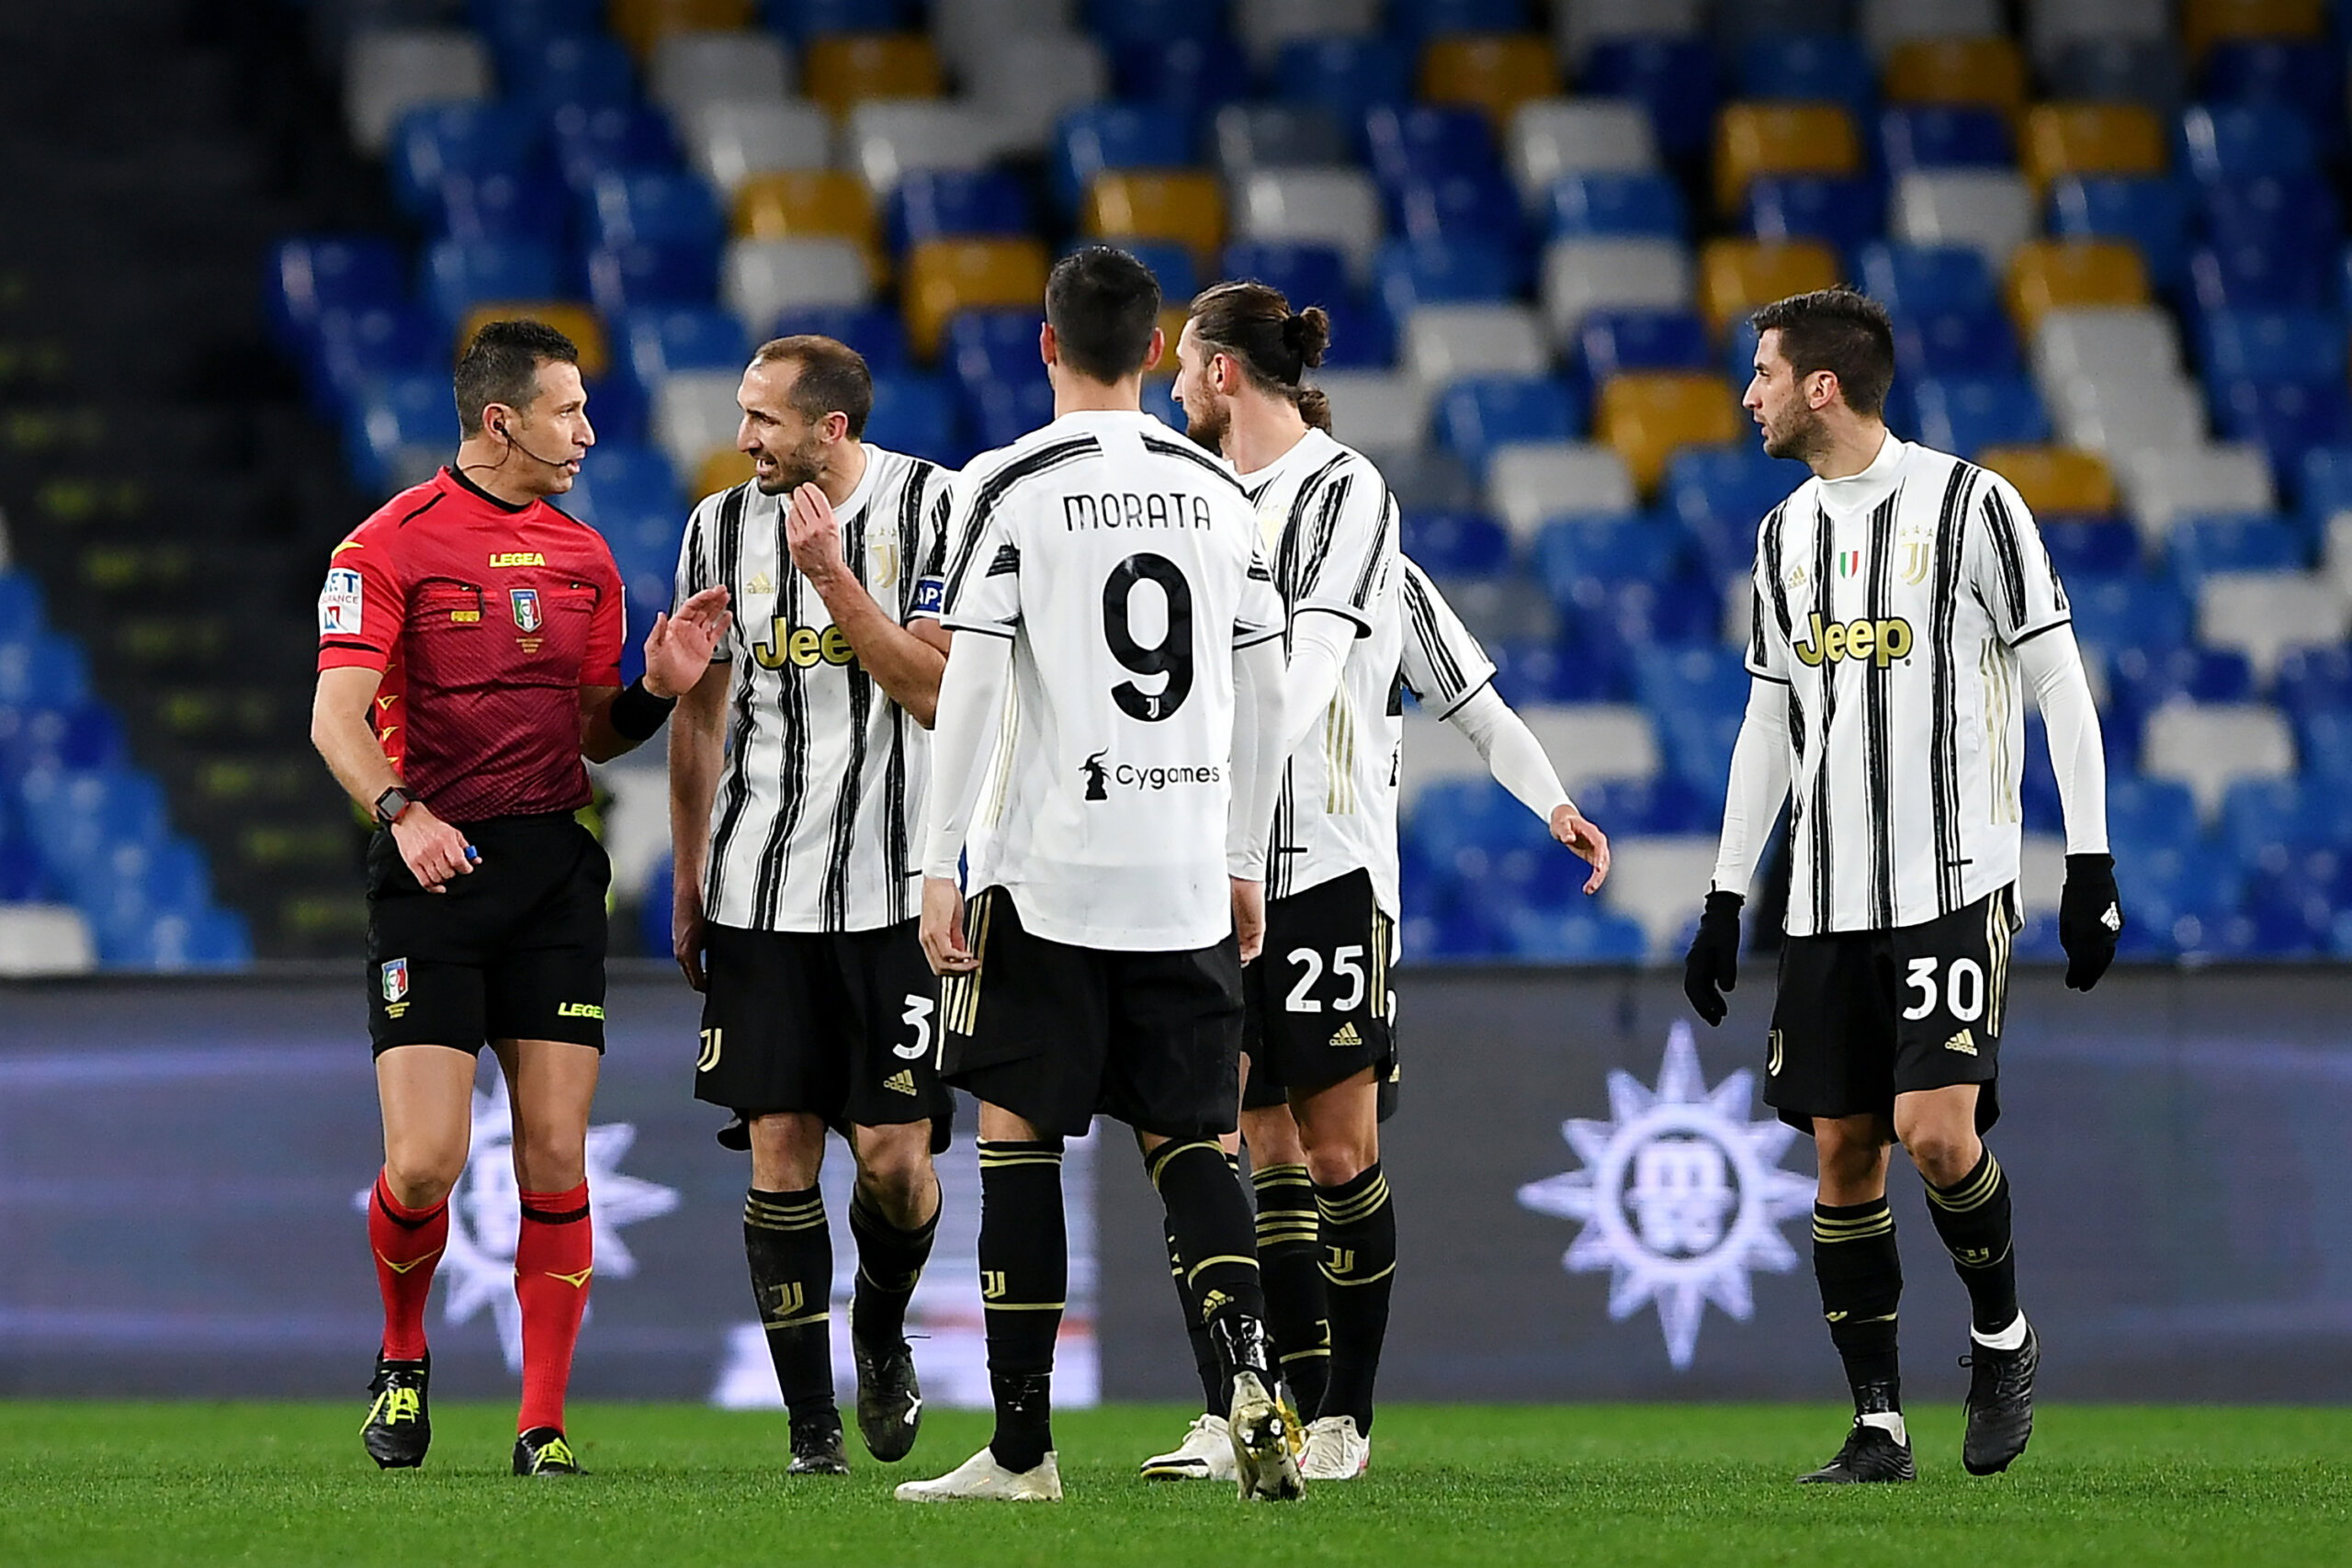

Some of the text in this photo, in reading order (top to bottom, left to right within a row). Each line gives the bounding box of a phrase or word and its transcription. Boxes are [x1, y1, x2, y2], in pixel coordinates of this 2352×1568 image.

[1063, 493, 1211, 531] MORATA
[489, 553, 547, 568] LEGEA
[752, 615, 870, 671] Jee
[1102, 553, 1193, 722] 9
[1792, 611, 1914, 670] Jeep
[1116, 764, 1220, 790] Cygames
[1284, 945, 1365, 1012] 25
[1902, 956, 1984, 1022] 30
[557, 1001, 605, 1021] LEGE
[892, 994, 934, 1060] 3
